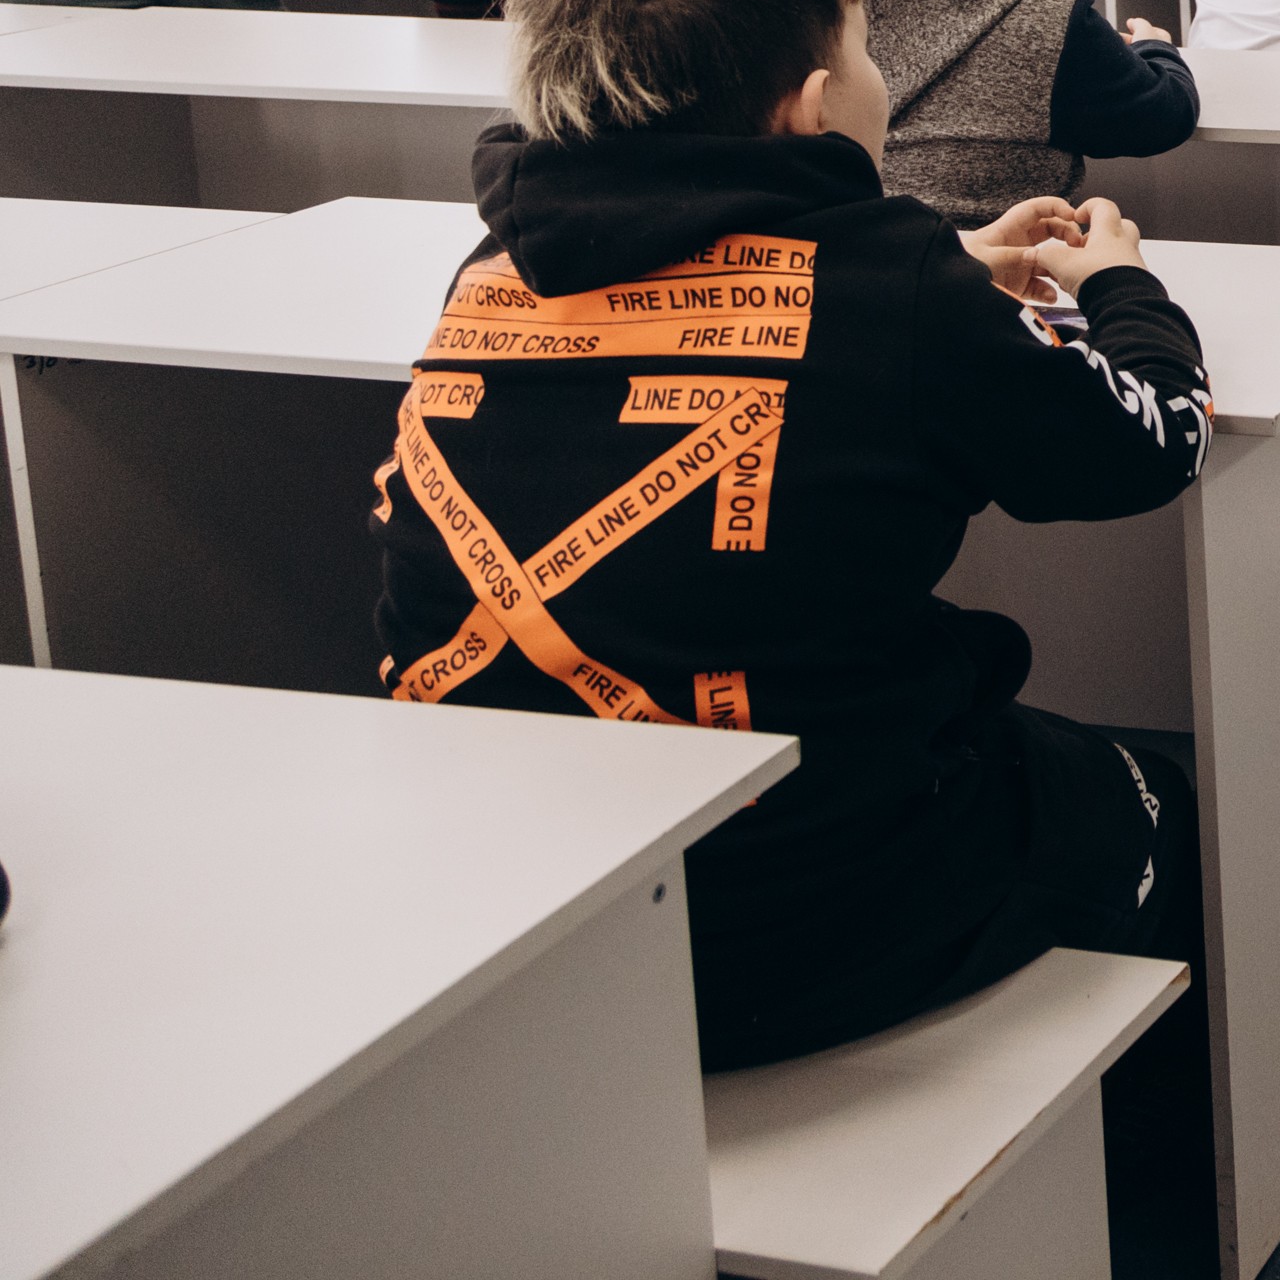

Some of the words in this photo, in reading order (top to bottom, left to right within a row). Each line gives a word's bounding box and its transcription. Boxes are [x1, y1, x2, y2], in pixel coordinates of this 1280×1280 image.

[722, 244, 782, 269] LINE
[475, 285, 538, 310] CROSS
[606, 290, 662, 313] FIRE
[668, 287, 723, 311] LINE
[731, 286, 766, 309] DO
[450, 328, 478, 350] DO
[476, 330, 523, 353] NOT
[522, 334, 600, 354] CROSS
[678, 326, 735, 349] FIRE
[741, 325, 801, 347] LINE
[630, 388, 683, 411] LINE
[688, 388, 725, 411] DO
[732, 441, 763, 488] NO
[728, 496, 756, 531] DO
[420, 631, 487, 691] CROSS
[533, 537, 586, 587] FIRE
[585, 496, 641, 547] LINE
[638, 470, 677, 507] DO
[675, 429, 728, 477] NOT
[729, 402, 770, 436] CR
[406, 426, 431, 474] LINE
[421, 467, 445, 502] DO
[440, 495, 478, 541] NOT
[467, 537, 521, 610] CROSS
[572, 663, 627, 709] FIRE
